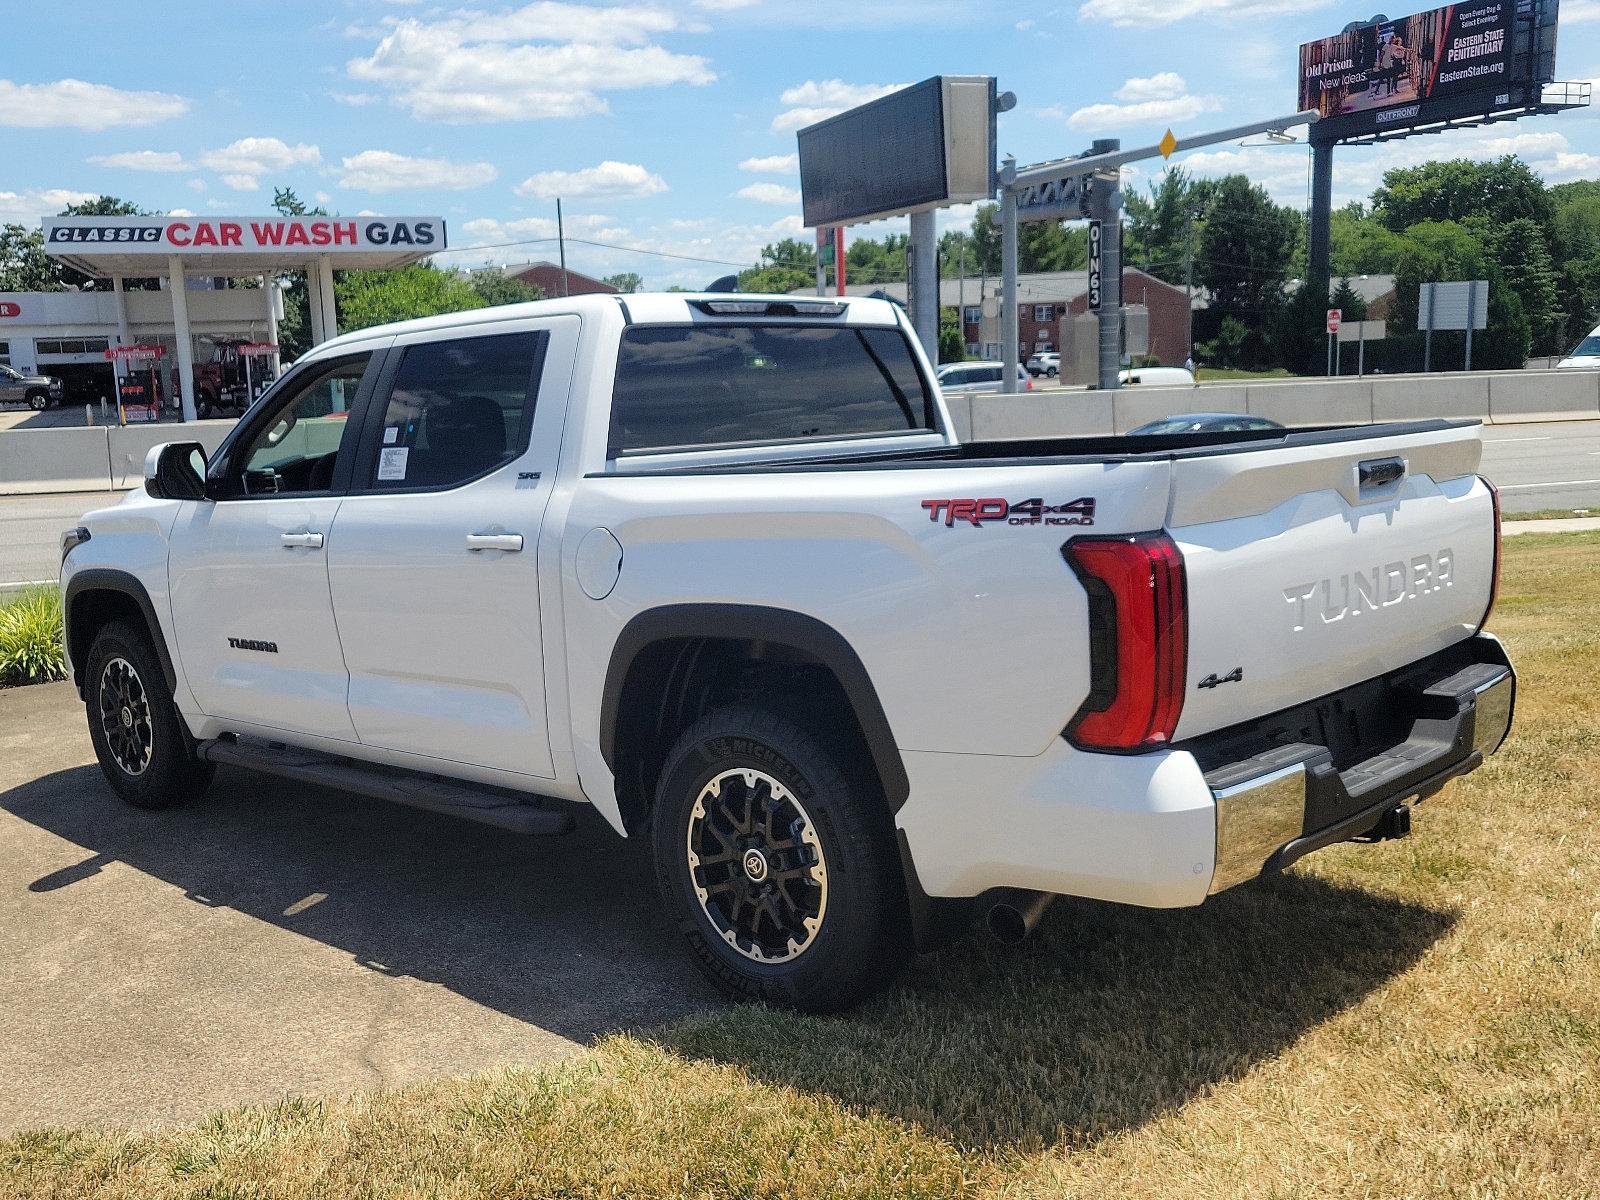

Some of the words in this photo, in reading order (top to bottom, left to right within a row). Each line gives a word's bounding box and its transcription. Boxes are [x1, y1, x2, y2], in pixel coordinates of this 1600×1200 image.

[1462, 19, 1476, 28] Select
[1453, 33, 1484, 49] EASTERN
[1484, 28, 1505, 42] STATE
[1447, 39, 1505, 62] PENITENTIARY
[1305, 63, 1322, 78] Old
[1439, 62, 1504, 83] EasternState.org
[1319, 78, 1340, 90] New
[1377, 107, 1416, 121] OUTFRONT
[56, 228, 158, 242] CLASSIC
[165, 222, 243, 247] CAR
[250, 222, 359, 246] WASH
[365, 222, 435, 246] GAS
[921, 497, 1009, 528] TRD
[1008, 497, 1096, 517] 4x4
[1008, 517, 1042, 526] OFF
[1045, 517, 1095, 526] ROAD
[1282, 547, 1454, 632] TUNDRA
[227, 637, 279, 653] TUNDRA
[733, 739, 812, 795] MICHELIN
